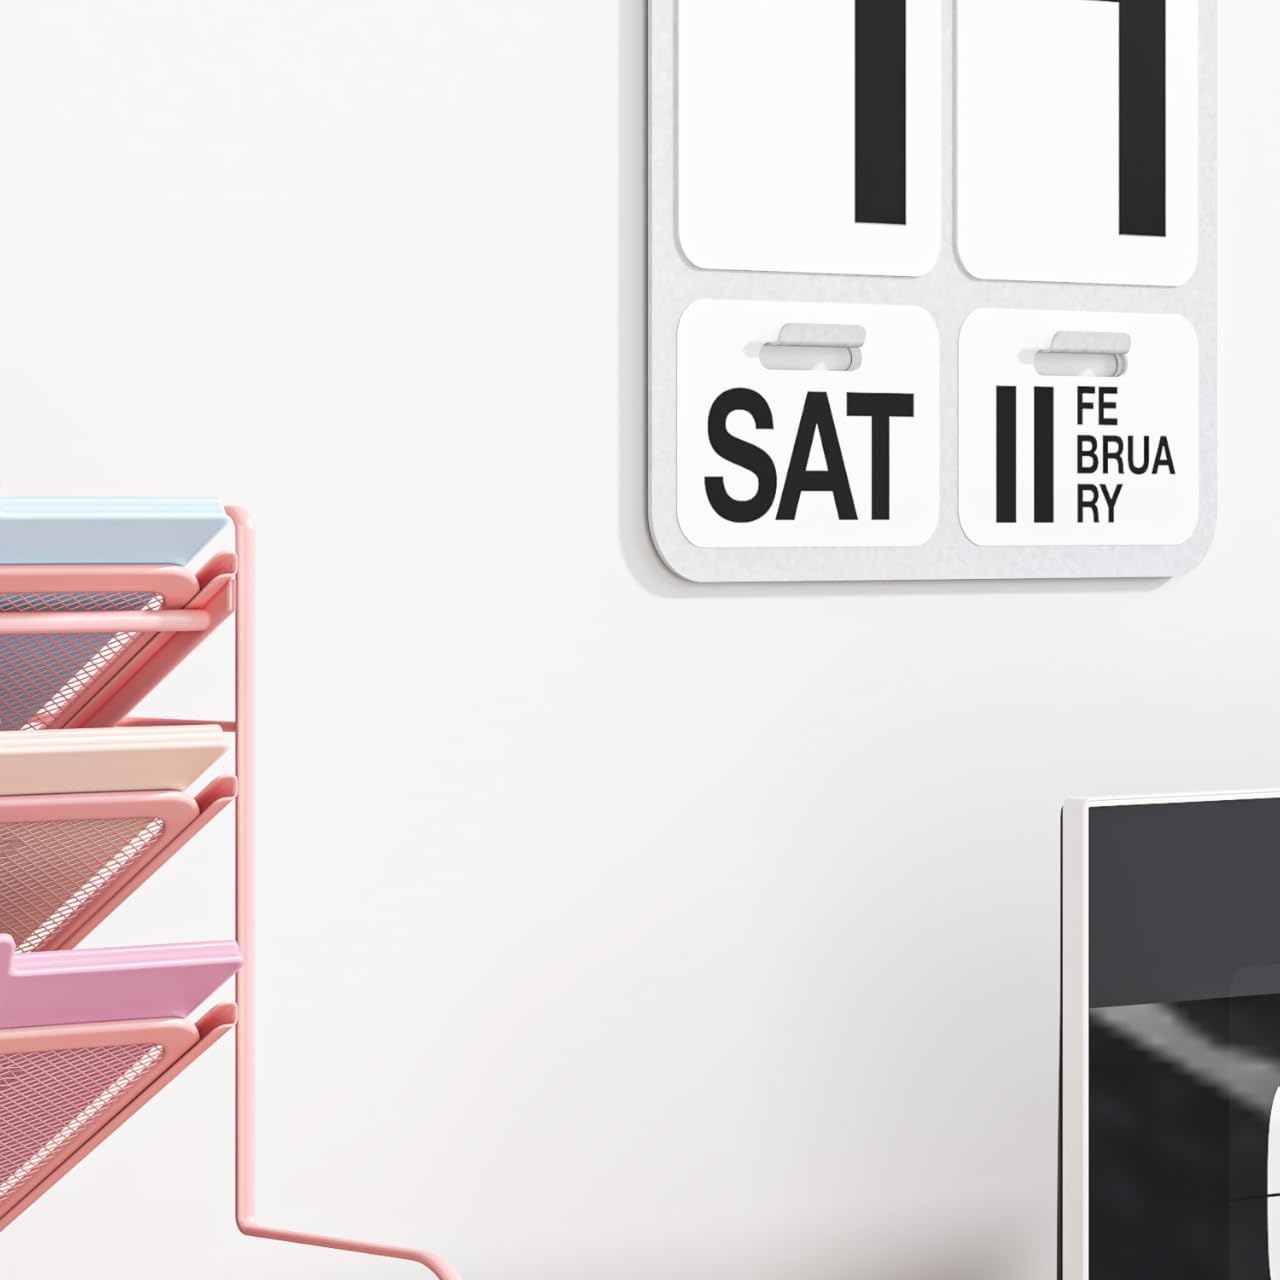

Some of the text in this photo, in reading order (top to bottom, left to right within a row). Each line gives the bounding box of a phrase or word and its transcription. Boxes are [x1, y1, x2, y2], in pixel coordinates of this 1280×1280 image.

[1077, 386, 1118, 426] FE
[704, 387, 914, 523] SAT
[1077, 435, 1176, 475] BRUA
[1077, 484, 1124, 523] RY
